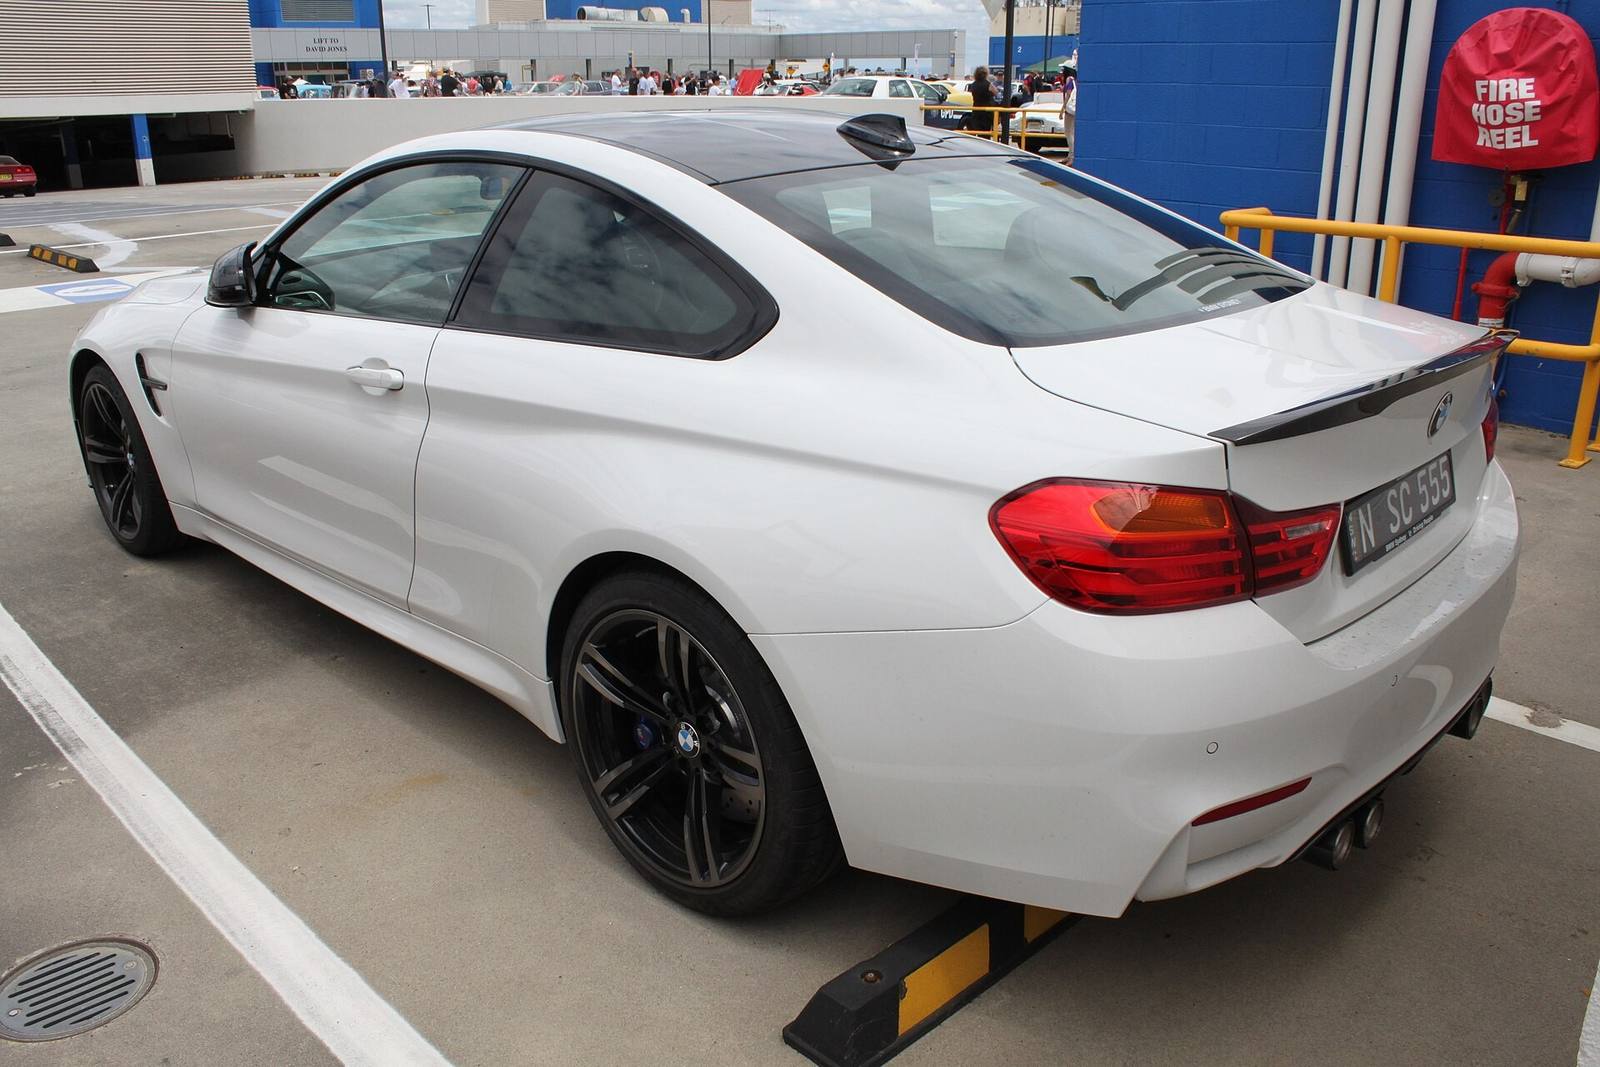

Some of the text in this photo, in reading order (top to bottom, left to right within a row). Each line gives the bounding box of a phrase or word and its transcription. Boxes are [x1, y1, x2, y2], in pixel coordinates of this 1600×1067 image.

[1475, 78, 1536, 102] FIRE
[1471, 100, 1542, 126] HOSE
[1476, 125, 1539, 149] REEL
[1357, 503, 1375, 553] N
[1387, 481, 1413, 534] SC
[1417, 455, 1451, 513] 555
